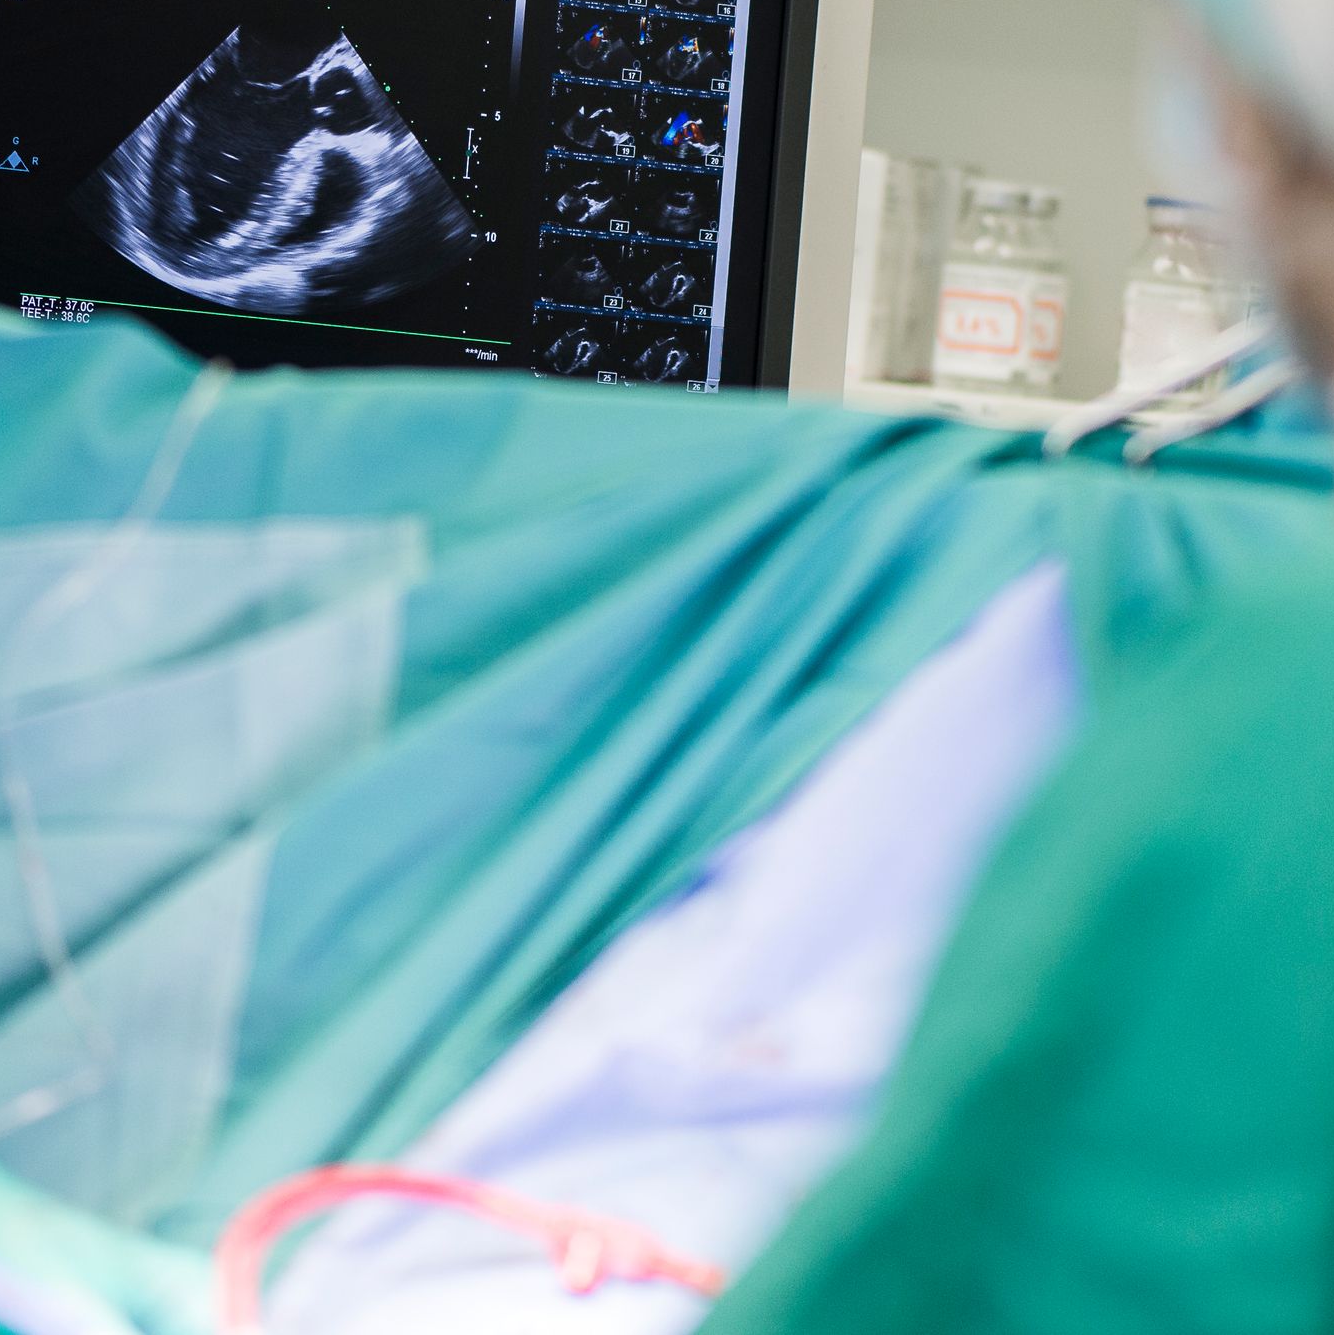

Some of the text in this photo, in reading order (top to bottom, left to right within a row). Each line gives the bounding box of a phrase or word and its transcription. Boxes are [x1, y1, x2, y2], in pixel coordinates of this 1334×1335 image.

[723, 7, 731, 15] 16
[628, 72, 636, 80] 17
[717, 82, 725, 90] 18
[494, 110, 501, 122] 5
[12, 136, 20, 145] G
[622, 147, 631, 155] 19
[32, 156, 39, 166] R
[710, 157, 719, 165] 20
[615, 223, 624, 231] 21
[485, 231, 497, 243] 10
[704, 232, 713, 240] 22
[21, 295, 95, 313] PAT.-T.: 37.0C
[609, 298, 618, 306] 23
[20, 306, 90, 324] TEE-T.: 38.6C
[698, 308, 707, 316] 24
[603, 374, 612, 383] 25
[692, 382, 701, 391] 26
